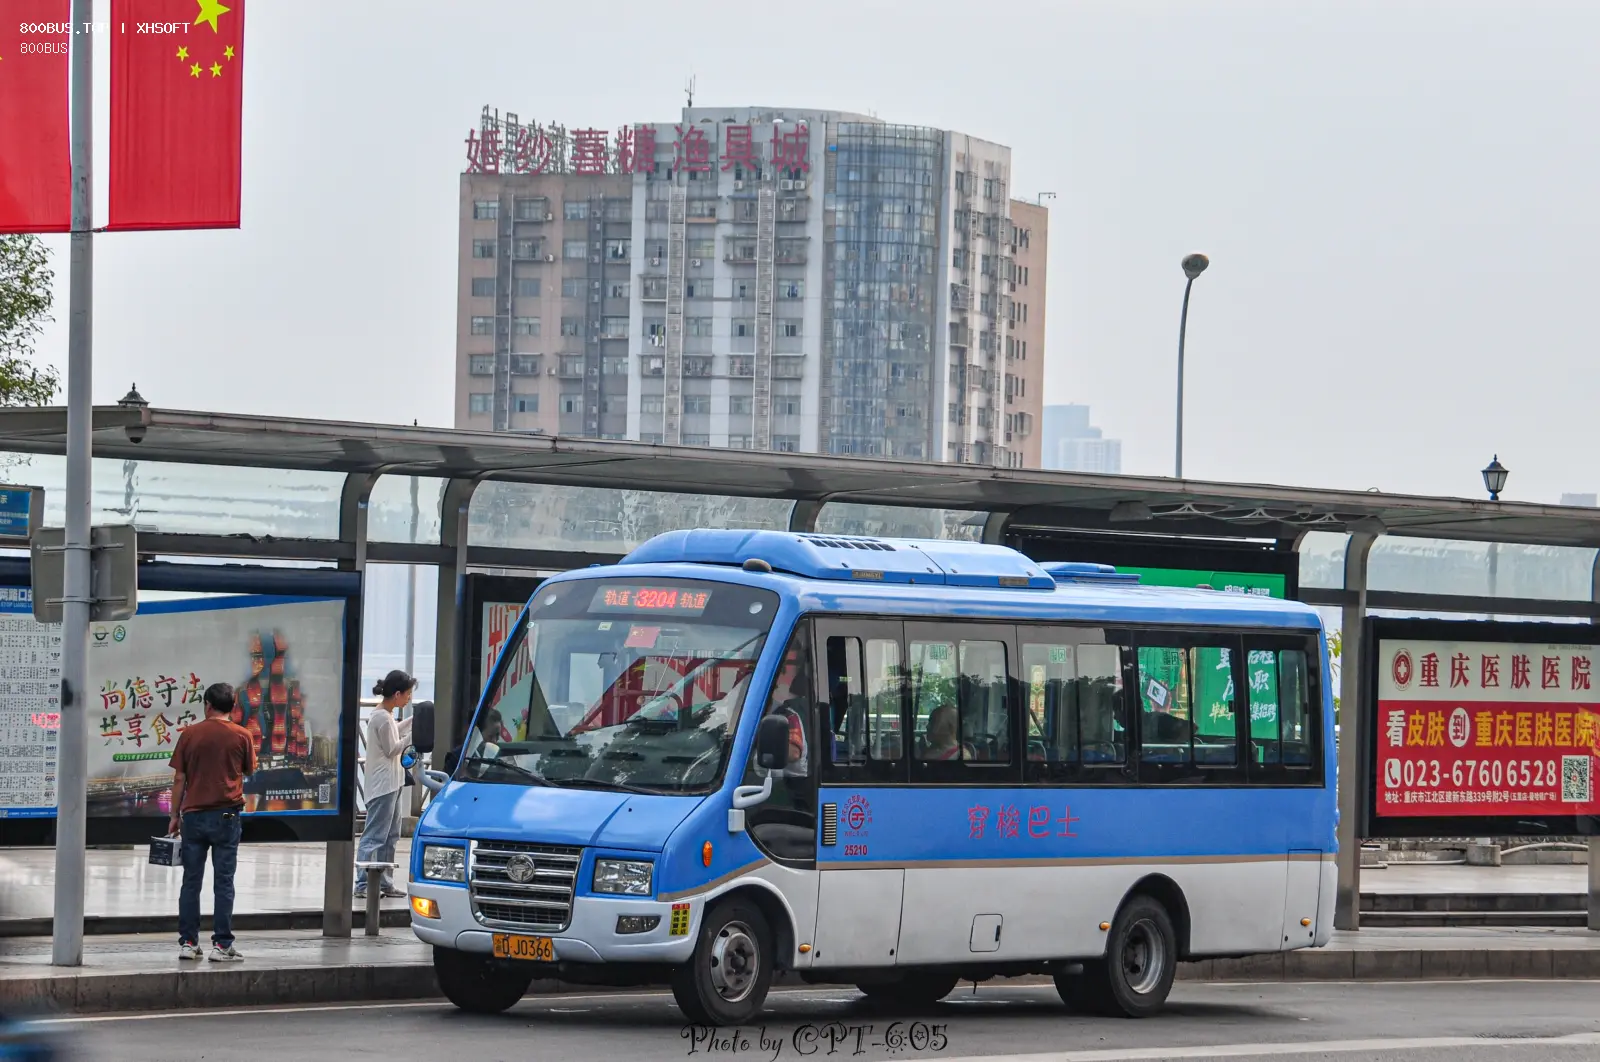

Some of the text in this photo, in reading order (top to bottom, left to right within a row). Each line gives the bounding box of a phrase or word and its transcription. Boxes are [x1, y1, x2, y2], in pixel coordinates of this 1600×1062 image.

[465, 124, 811, 176] 婚纱喜糖渔具城
[637, 588, 677, 609] 3204
[1419, 652, 1591, 691] 重庆医肤医院
[100, 672, 204, 711] 尚德守法
[968, 804, 1081, 839] 穿梭巴士
[844, 844, 868, 856] 25210
